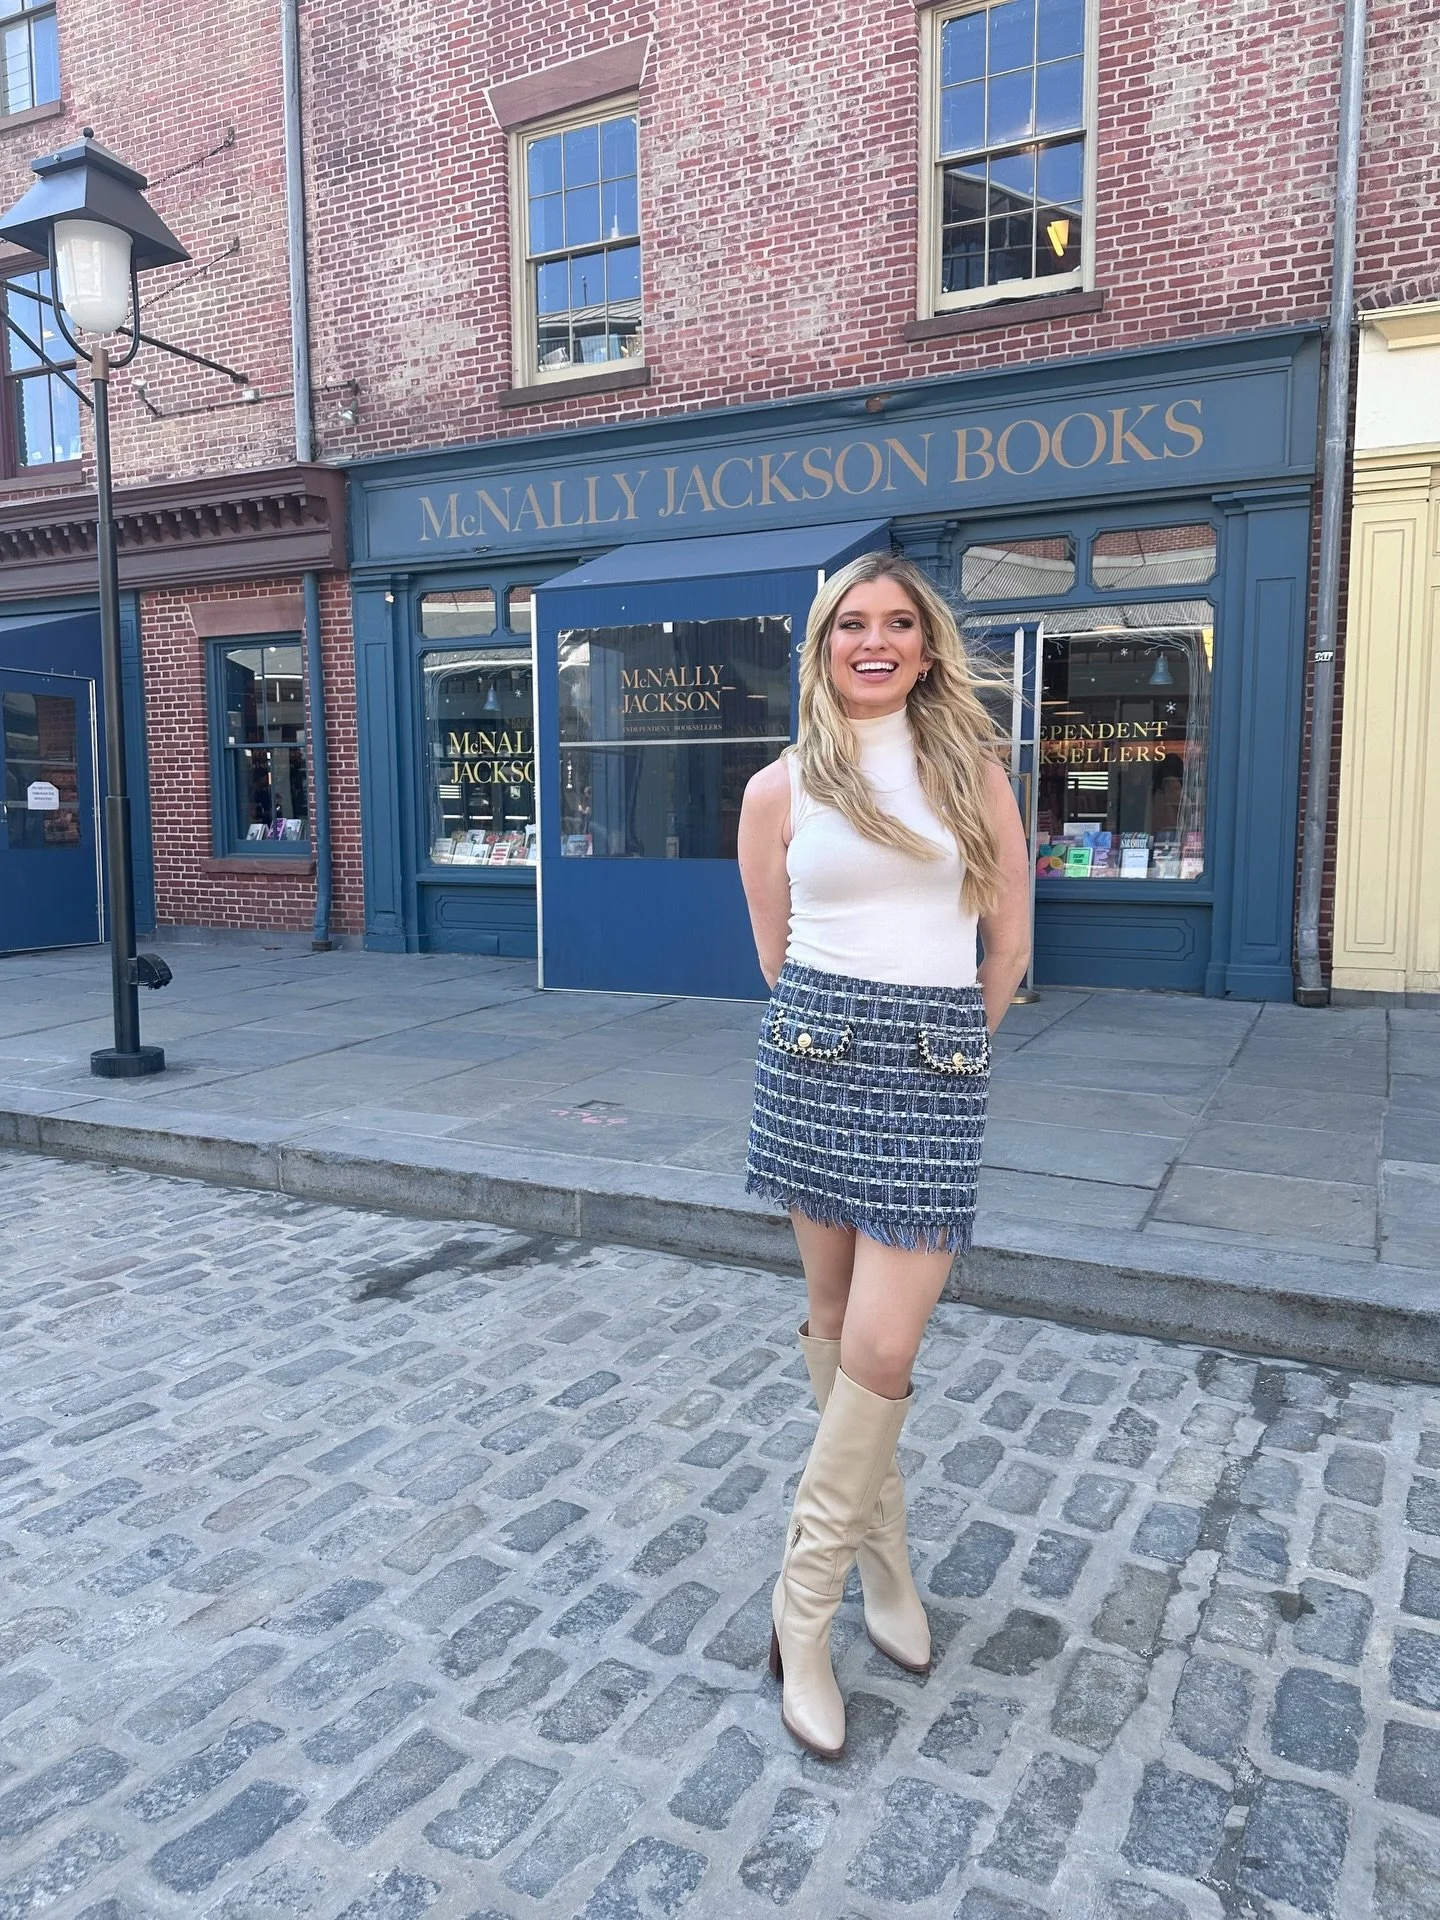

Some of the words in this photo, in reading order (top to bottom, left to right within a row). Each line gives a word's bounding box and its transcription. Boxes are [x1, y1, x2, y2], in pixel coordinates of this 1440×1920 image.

[418, 470, 649, 542] McNALLY
[658, 432, 936, 518] JACKSON
[949, 399, 1205, 484] BOOKS
[620, 664, 725, 690] McNALLY
[621, 690, 722, 714] JACKSON
[622, 725, 671, 734] INDEPENDENT
[674, 723, 723, 732] BOOKSELLERS
[448, 730, 535, 756] McNAL
